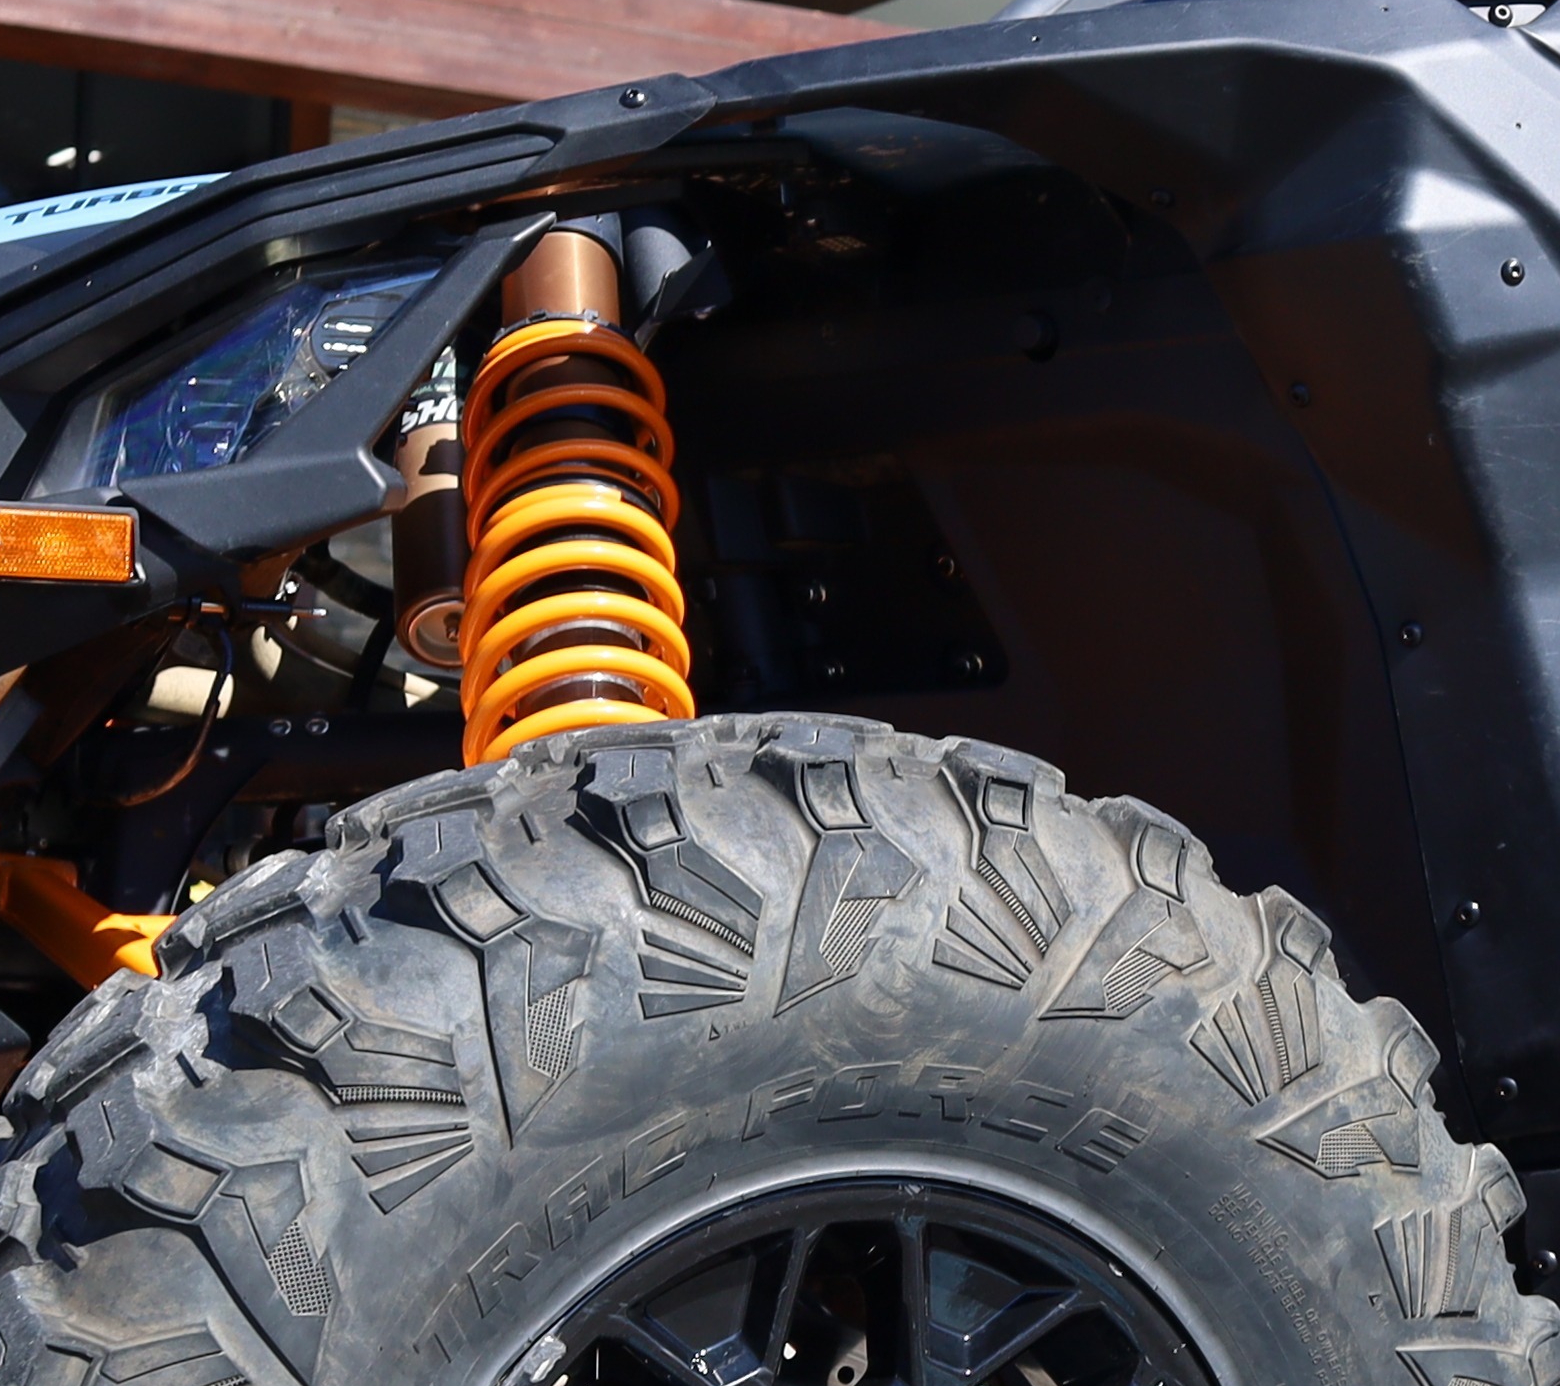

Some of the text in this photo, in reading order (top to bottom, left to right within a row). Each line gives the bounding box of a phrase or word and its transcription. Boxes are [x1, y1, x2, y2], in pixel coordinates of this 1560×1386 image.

[412, 1060, 1150, 1364] TRAC FORCE
[1279, 1262, 1307, 1308] LABEL
